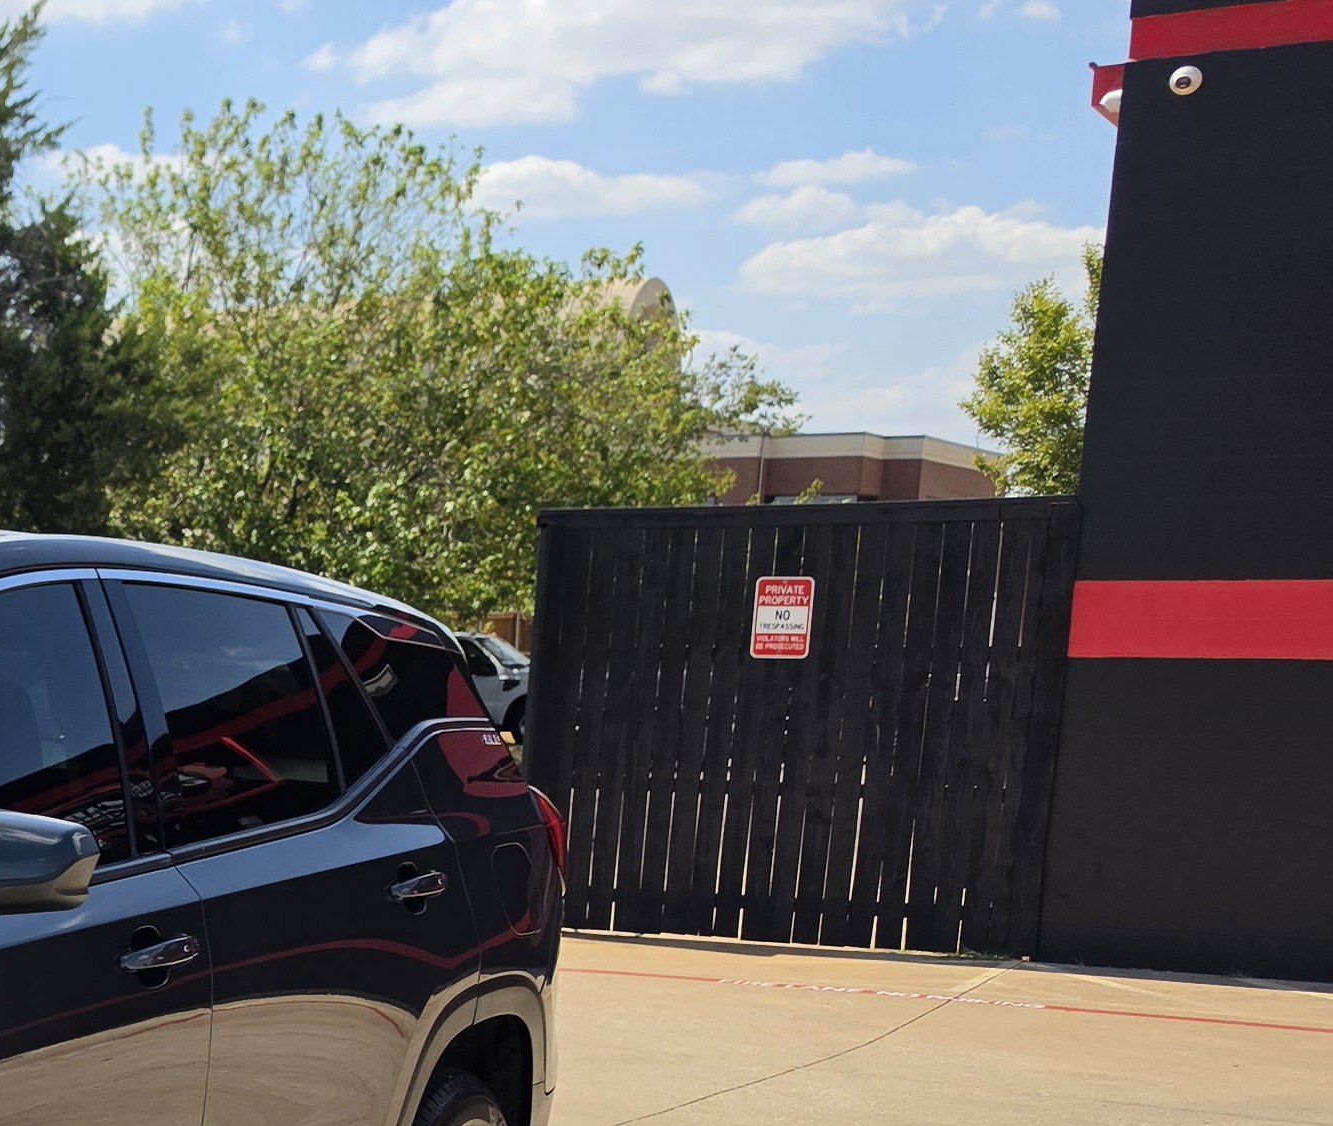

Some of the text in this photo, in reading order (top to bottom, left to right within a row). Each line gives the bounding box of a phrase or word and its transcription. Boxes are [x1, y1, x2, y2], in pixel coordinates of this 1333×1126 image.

[765, 585, 805, 595] PRIVATE
[759, 595, 810, 605] PROPERTY
[775, 610, 791, 621] NO
